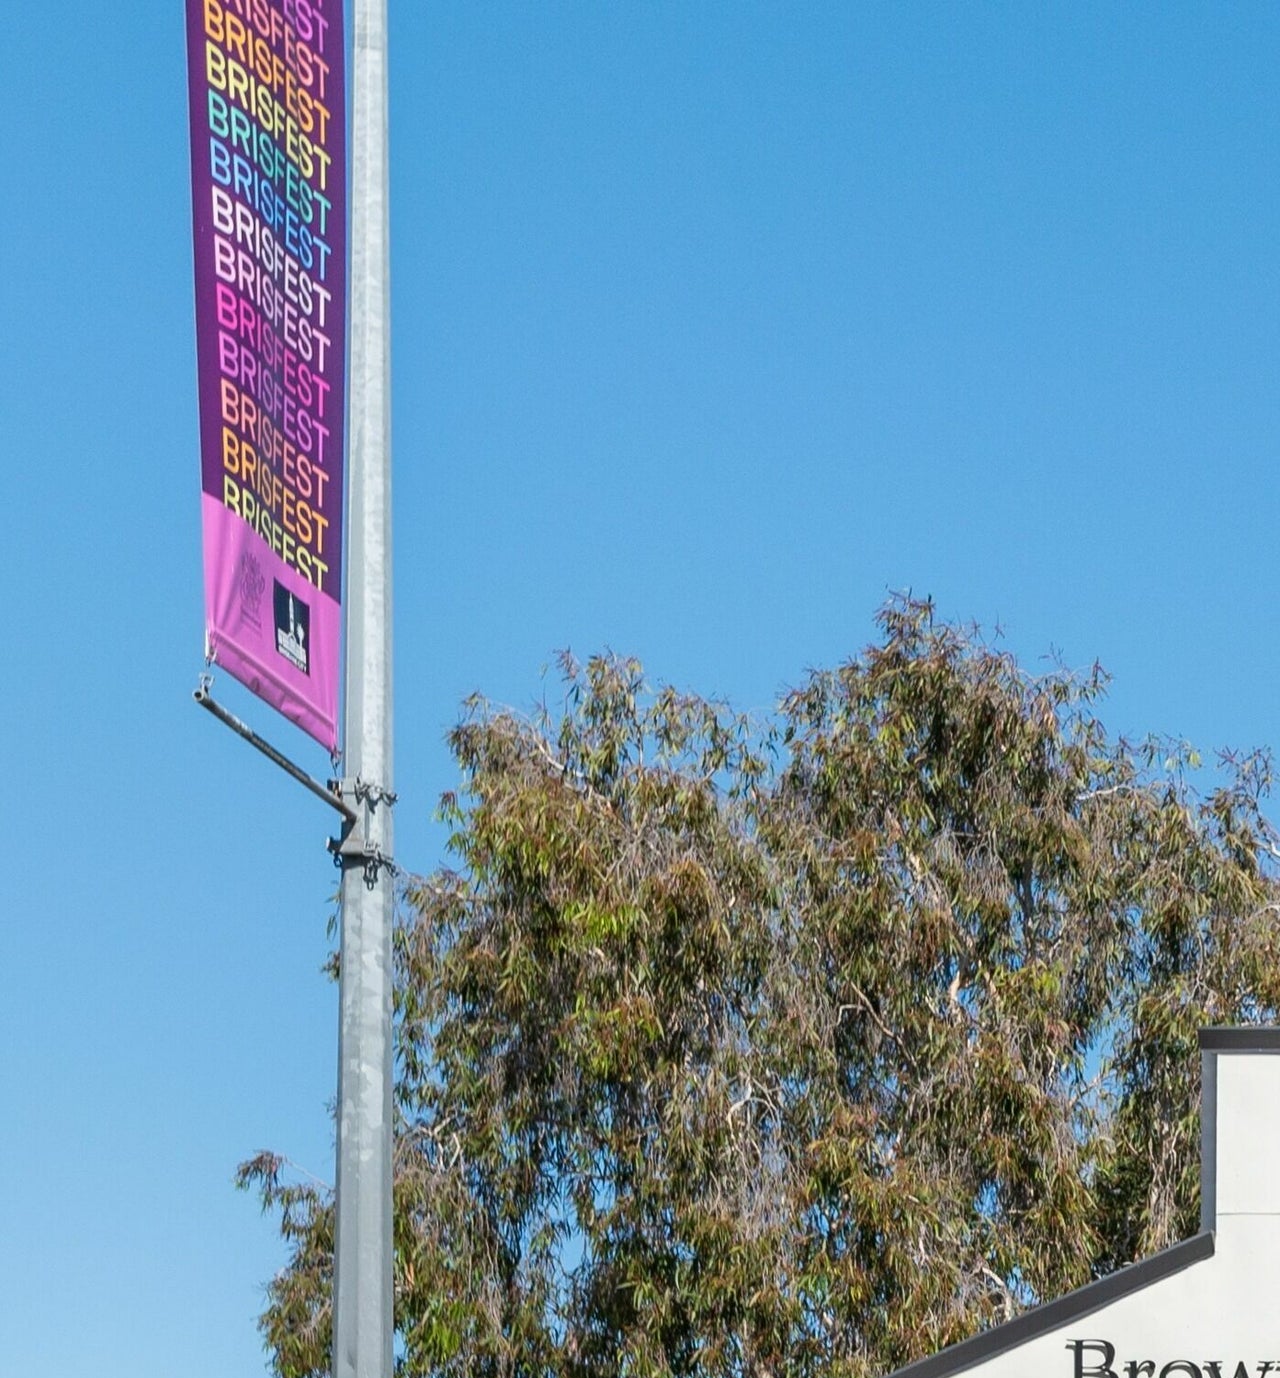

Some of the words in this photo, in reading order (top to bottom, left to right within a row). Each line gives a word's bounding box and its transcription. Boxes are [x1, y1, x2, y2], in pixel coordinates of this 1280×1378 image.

[204, 0, 330, 145] BRISFEST
[206, 39, 331, 191] BRISFEST
[225, 0, 330, 99] ISFEST
[208, 88, 331, 236] BRISFEST
[210, 136, 331, 282] BRISFEST
[212, 185, 331, 328] BRISFEST
[214, 234, 331, 374] BRISFEST
[216, 282, 330, 417] BRISFEST
[218, 330, 330, 463] BRISFEST
[220, 378, 330, 507] BRISFEST
[221, 426, 329, 554] BRISFEST
